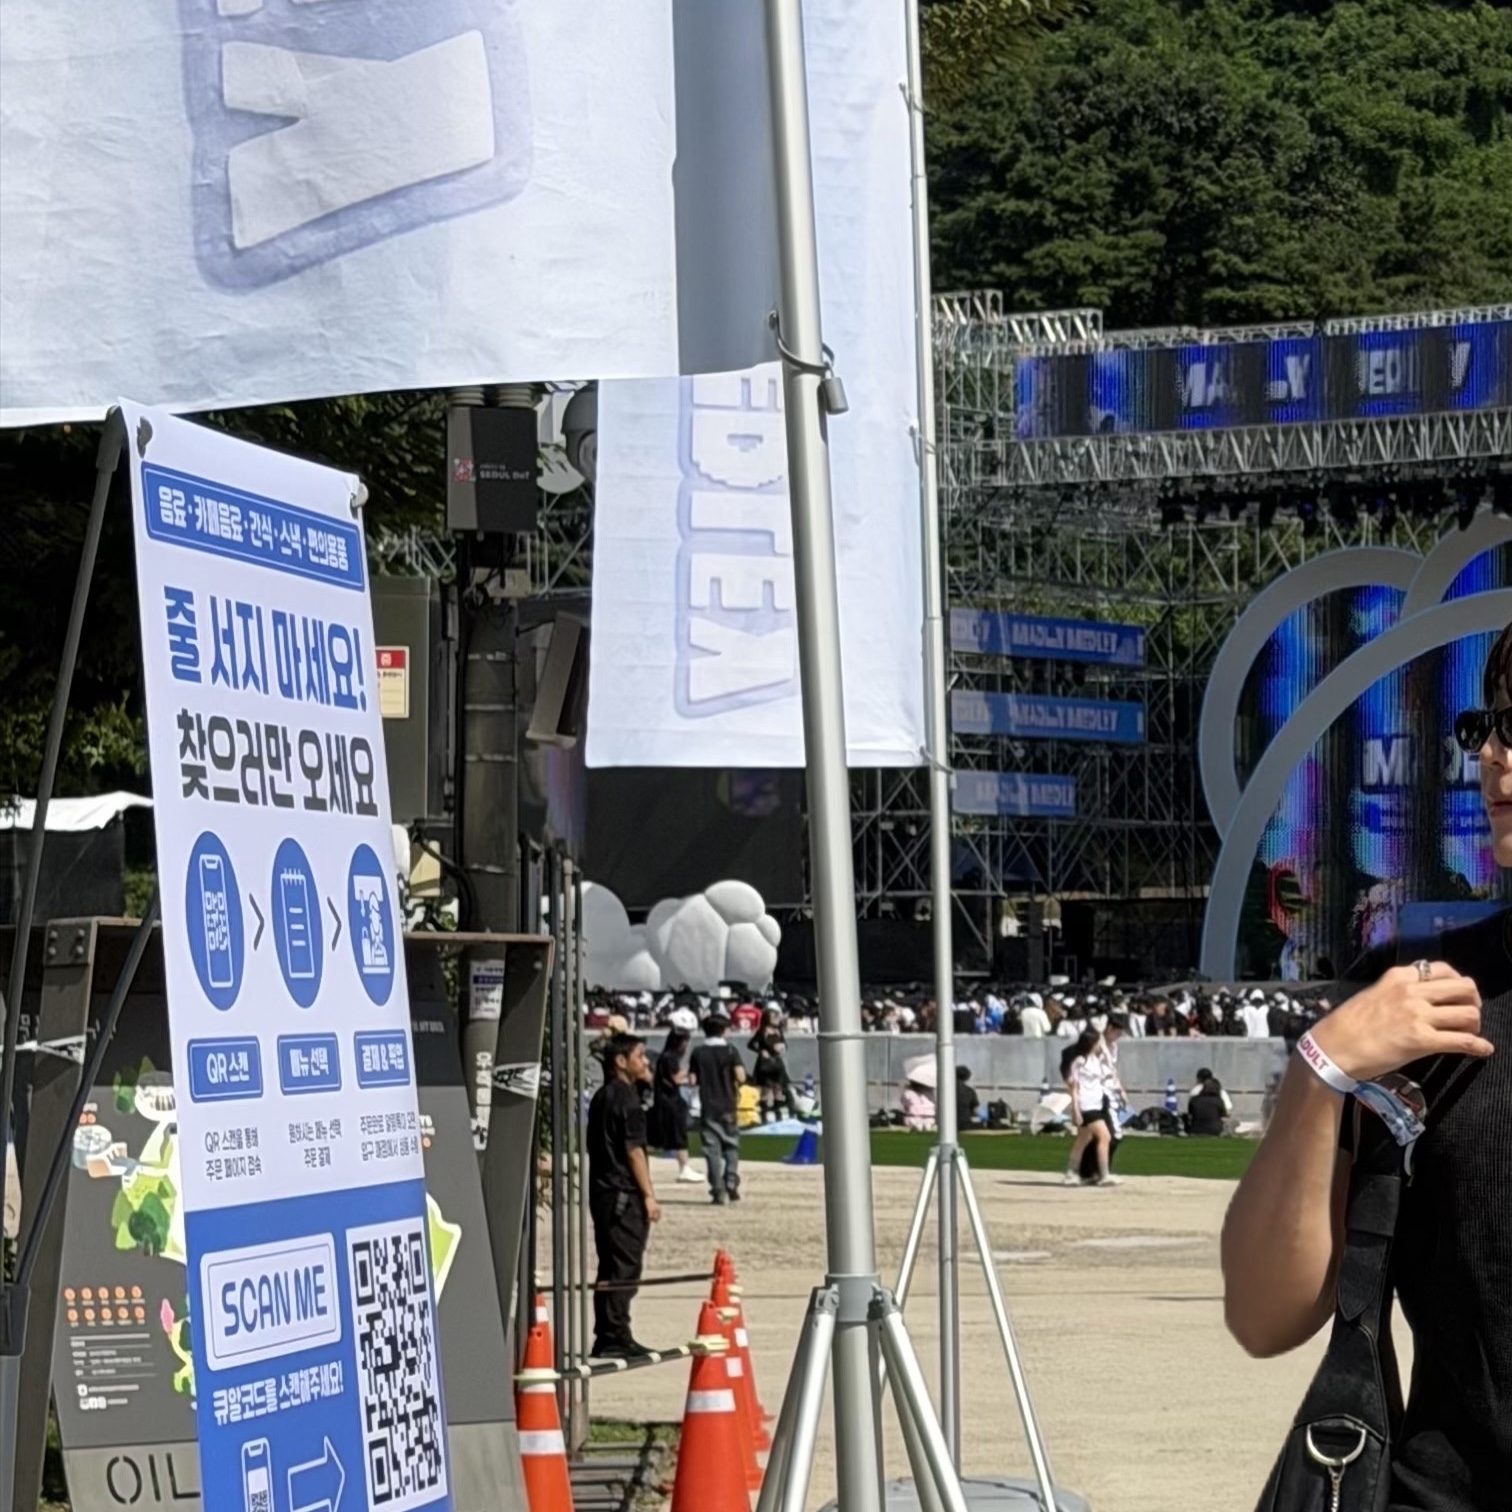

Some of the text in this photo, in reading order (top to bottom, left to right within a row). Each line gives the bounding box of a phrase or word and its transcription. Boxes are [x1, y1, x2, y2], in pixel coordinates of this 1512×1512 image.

[158, 486, 349, 571] 음료 카페음료 간식 스낵 편의용품
[163, 585, 367, 712] 줄 서지 마세요!
[177, 708, 379, 817] 찾으러만 오세요
[206, 1051, 250, 1085] QR 스캔
[289, 1047, 330, 1079] 메뉴 선택
[205, 1131, 220, 1153] QR
[222, 1128, 243, 1150] 스캔을
[304, 1147, 317, 1168] 주문
[206, 1158, 223, 1181] 주문
[222, 1264, 328, 1337] SCAN ME
[213, 1360, 344, 1426] 큐알코드를 스캔해주세요!
